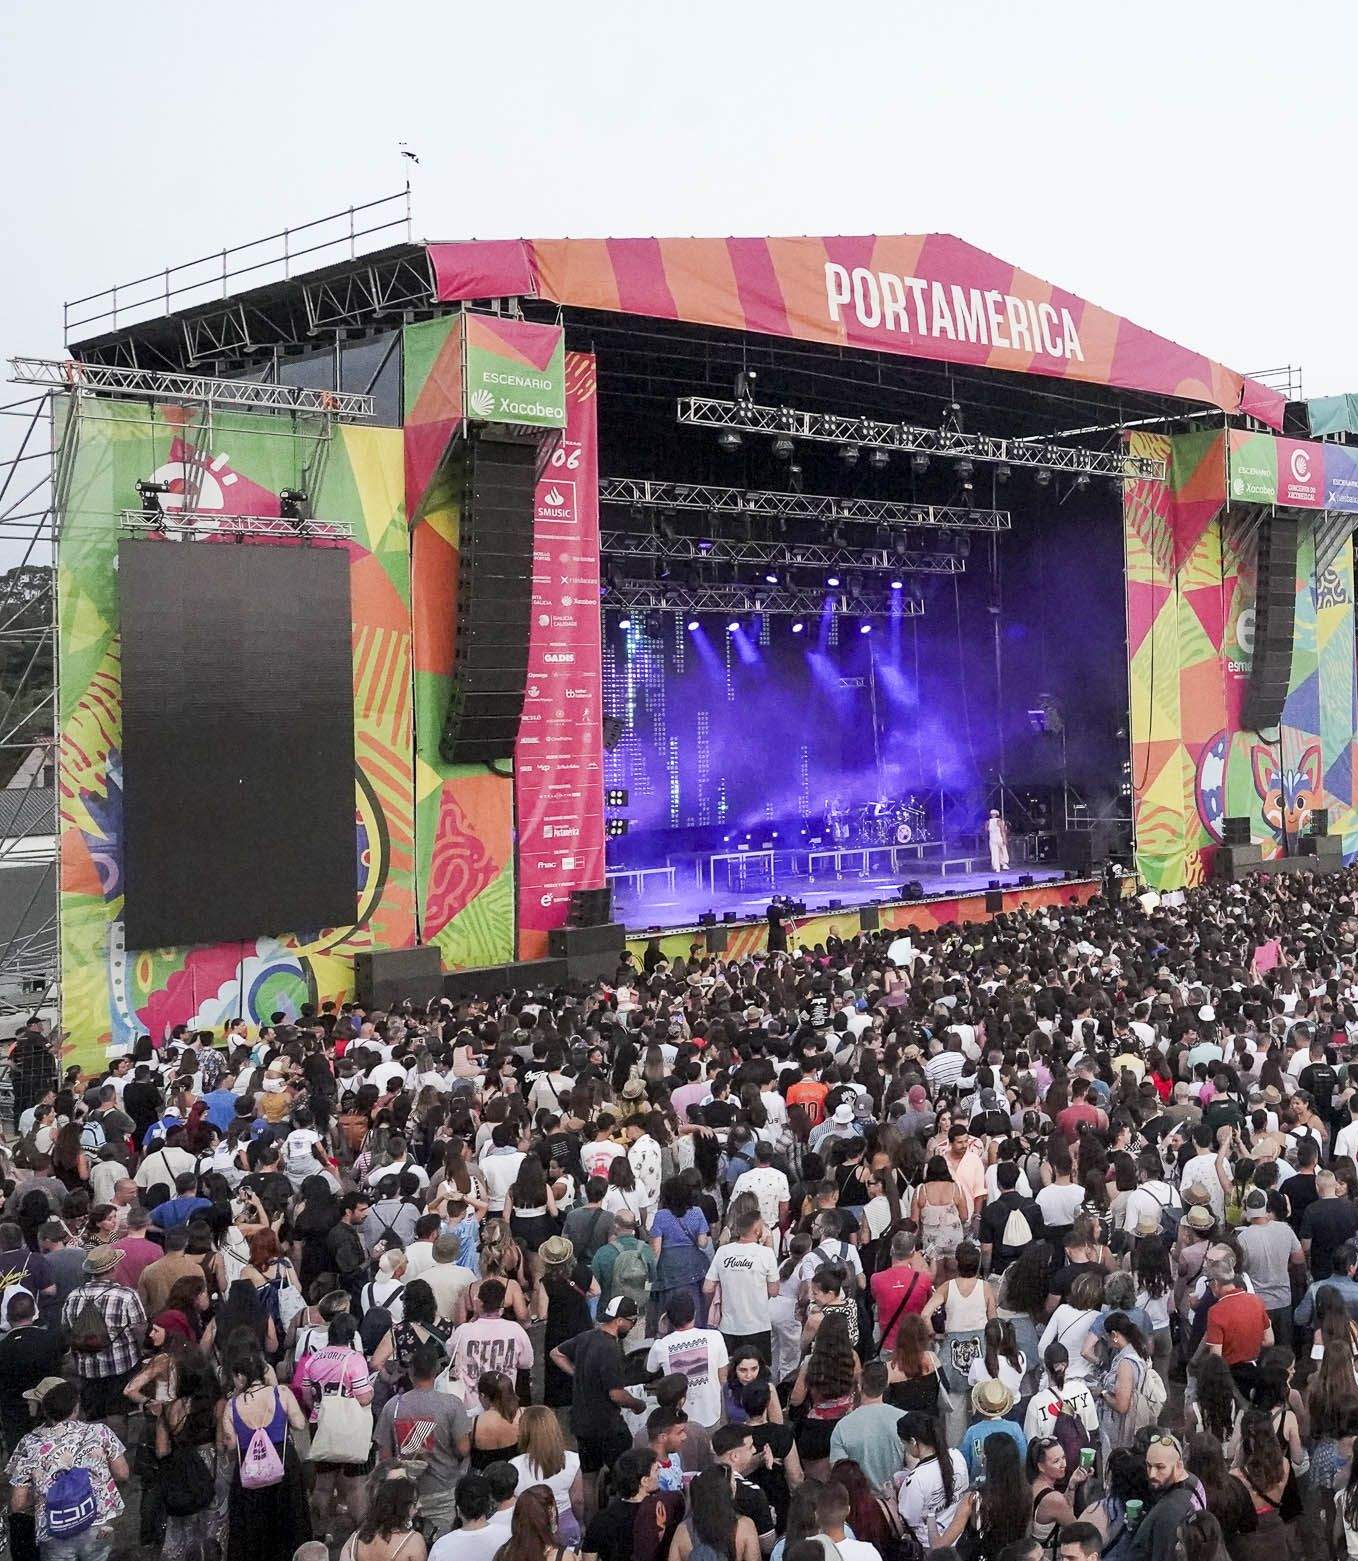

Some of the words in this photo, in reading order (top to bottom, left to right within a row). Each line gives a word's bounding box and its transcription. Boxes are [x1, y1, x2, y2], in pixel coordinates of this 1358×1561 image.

[824, 262, 1084, 361] PORTAMÉRICA
[483, 372, 552, 390] ESCENARIO
[499, 398, 563, 419] Xacobeo
[1246, 483, 1275, 495] Xacobeo
[538, 508, 571, 517] SMUSIC
[544, 653, 574, 662] GADIS
[538, 861, 557, 869] fnac
[723, 1256, 754, 1270] Hurley
[1039, 1406, 1049, 1421] I
